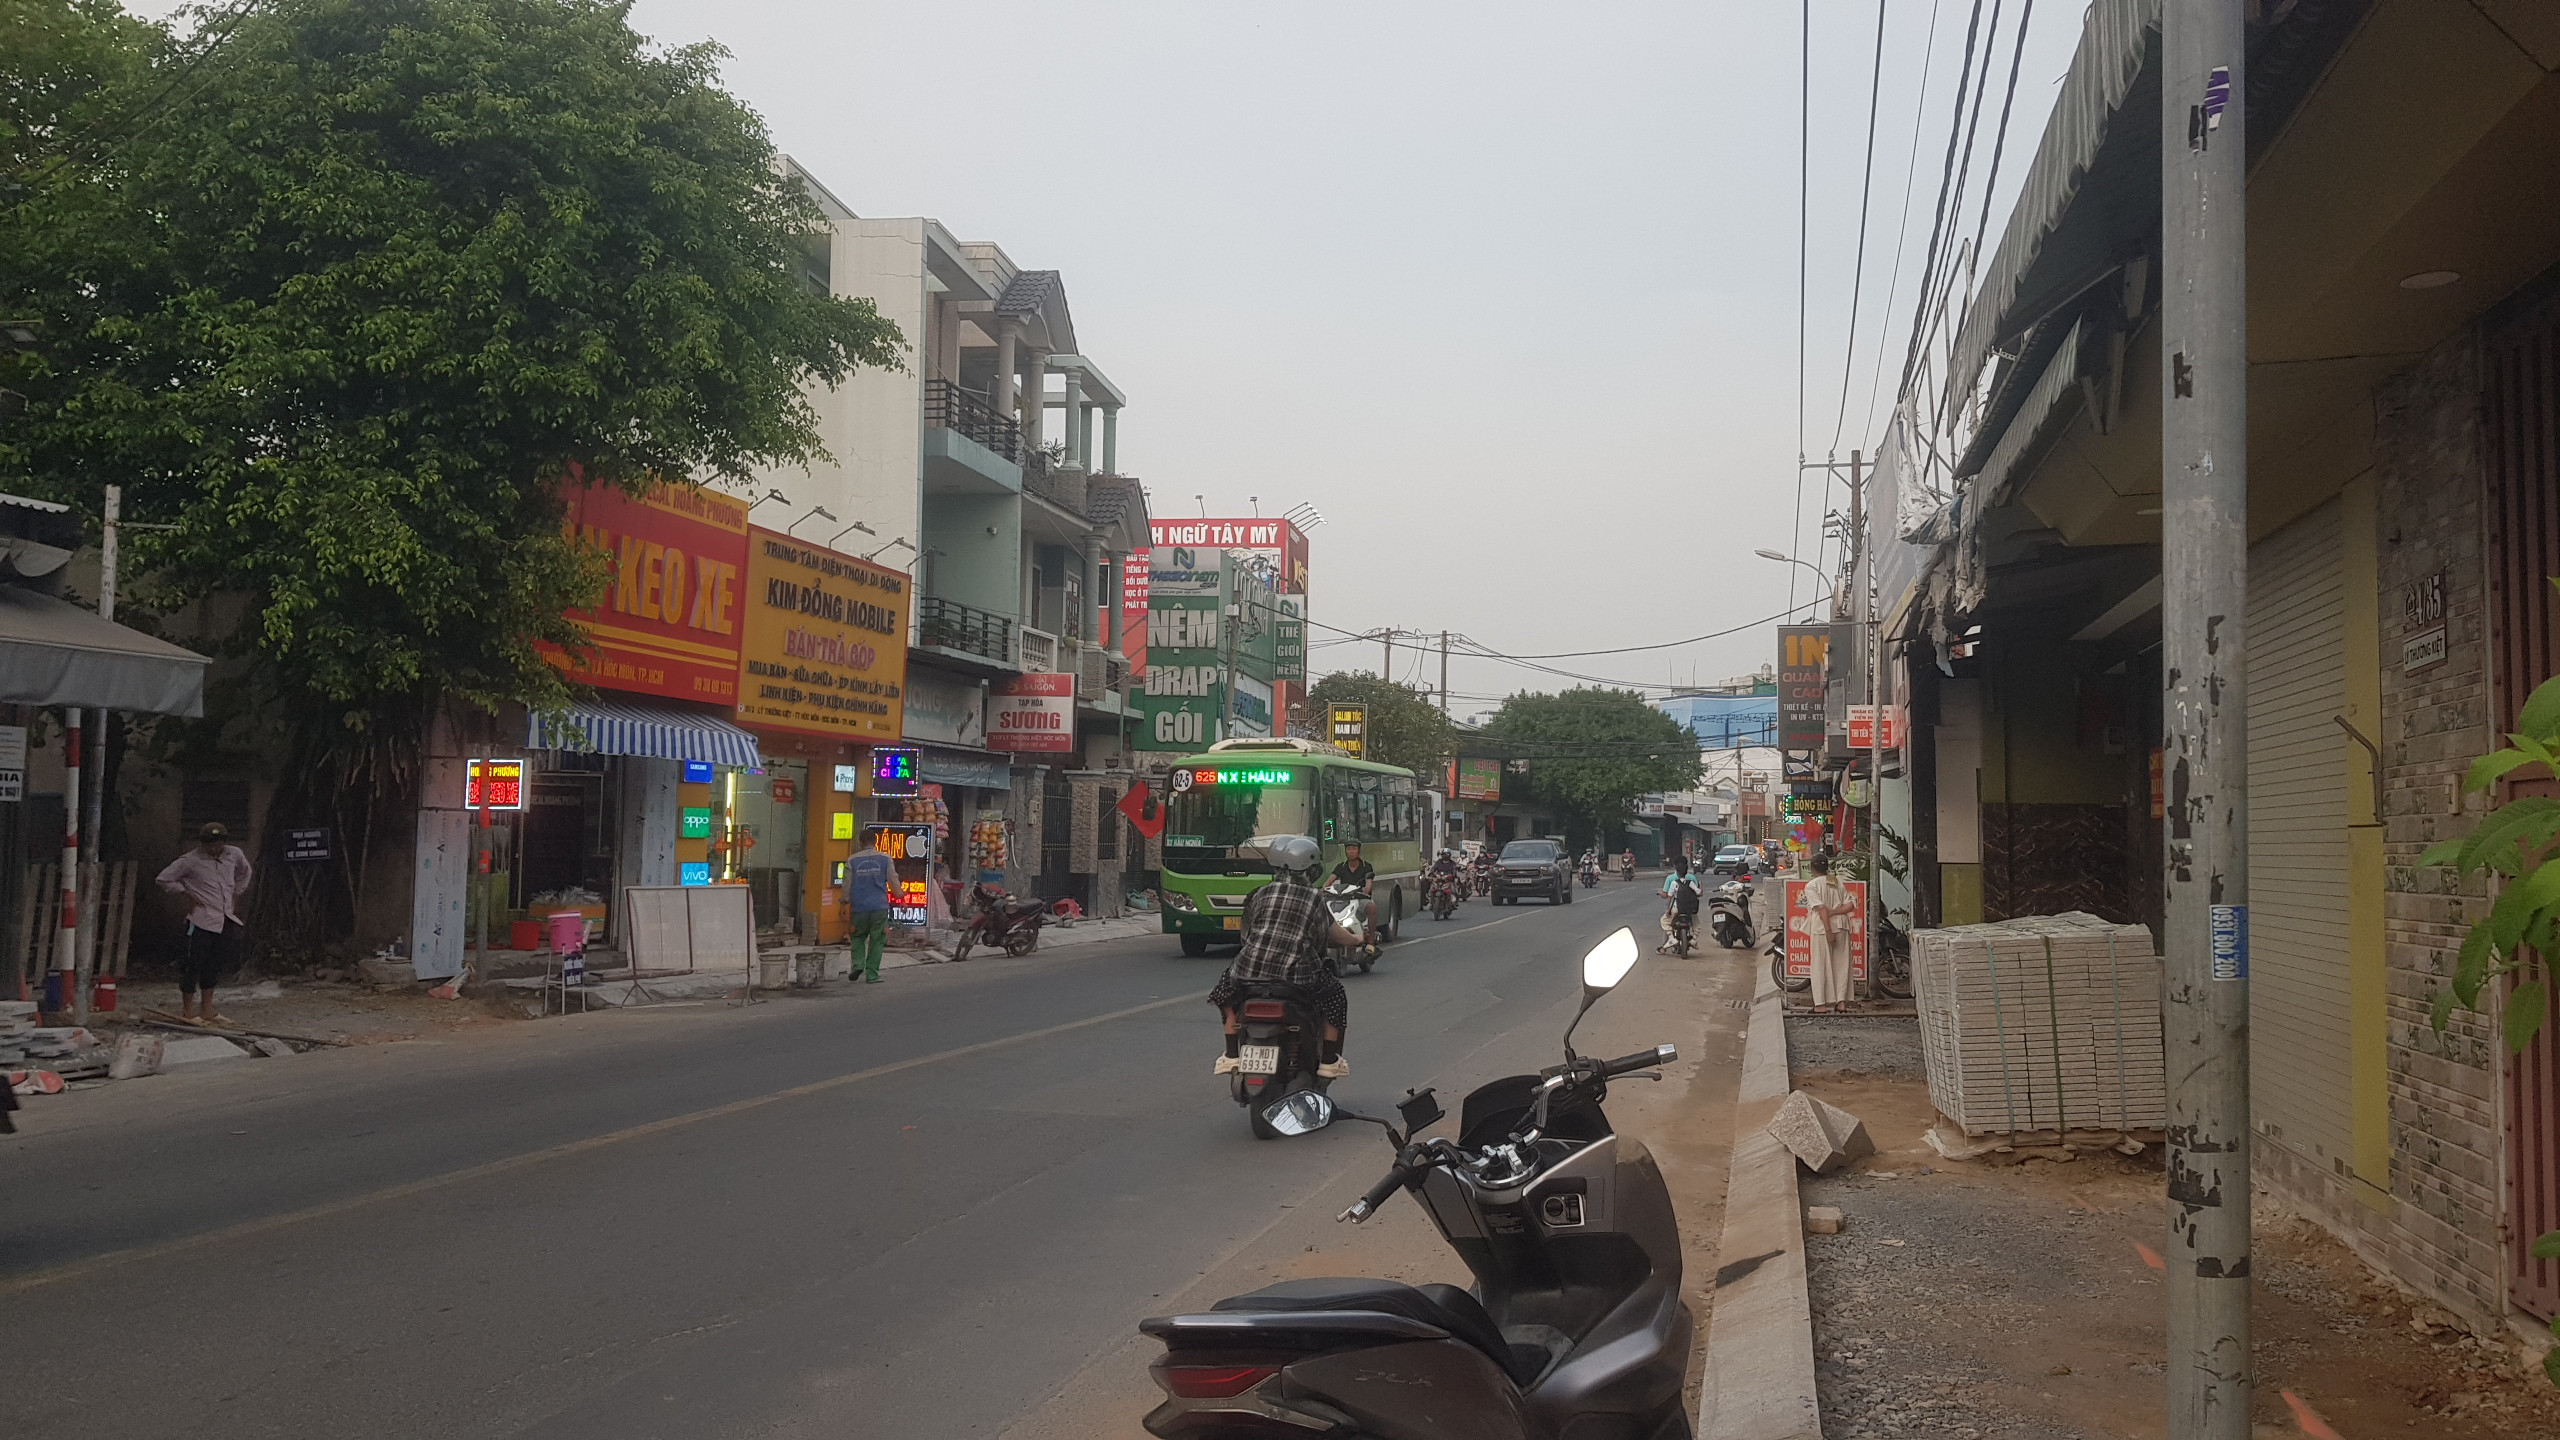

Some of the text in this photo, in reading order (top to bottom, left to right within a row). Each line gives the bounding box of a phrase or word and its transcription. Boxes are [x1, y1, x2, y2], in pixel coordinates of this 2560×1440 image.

[1168, 523, 1209, 544] NGỮ
[1212, 523, 1245, 544] TÂY
[1250, 523, 1279, 544] MỸ
[764, 540, 902, 594] TRUNG TÂM ĐIỆN THOẠI DI ĐỘNG
[1126, 564, 1141, 574] TIẾNG
[615, 535, 686, 625] KEO
[688, 555, 737, 636] XE
[1125, 589, 1136, 599] HỌC
[765, 577, 797, 610] KIM
[844, 599, 896, 635] MOBILE
[1147, 602, 1218, 655] NỆM
[1278, 625, 1299, 638] THẾ
[784, 626, 876, 672] BÁN TRẢ GÓP
[1276, 643, 1300, 657] GIỚI
[1785, 634, 1829, 667] IN
[747, 660, 767, 675] MUA
[791, 665, 810, 683] SỬA
[1276, 661, 1300, 676] NỆM
[1144, 665, 1218, 697] DRAP
[759, 684, 782, 700] LINH
[782, 686, 802, 706] KIỆN
[808, 692, 825, 710] PHỤ
[824, 694, 846, 712] KIỆN
[845, 696, 869, 713] CHÍNH
[1018, 697, 1044, 708] TẠP HÓA
[1783, 702, 1799, 711] THIẾT
[1800, 702, 1809, 711] KẾ
[1000, 710, 1061, 730] SƯƠNG
[1155, 700, 1203, 744] GỐI
[1335, 709, 1362, 721] SALON TÓC
[1790, 713, 1797, 721] IN
[1335, 722, 1361, 734] NAM NỮ
[1174, 772, 1190, 788] 62-5
[1195, 771, 1216, 782] 625
[1793, 794, 1816, 811] HỒNG
[684, 816, 709, 828] oppo
[2212, 907, 2236, 978] 0931.600.200
[1242, 1059, 1273, 1071] 693.54
